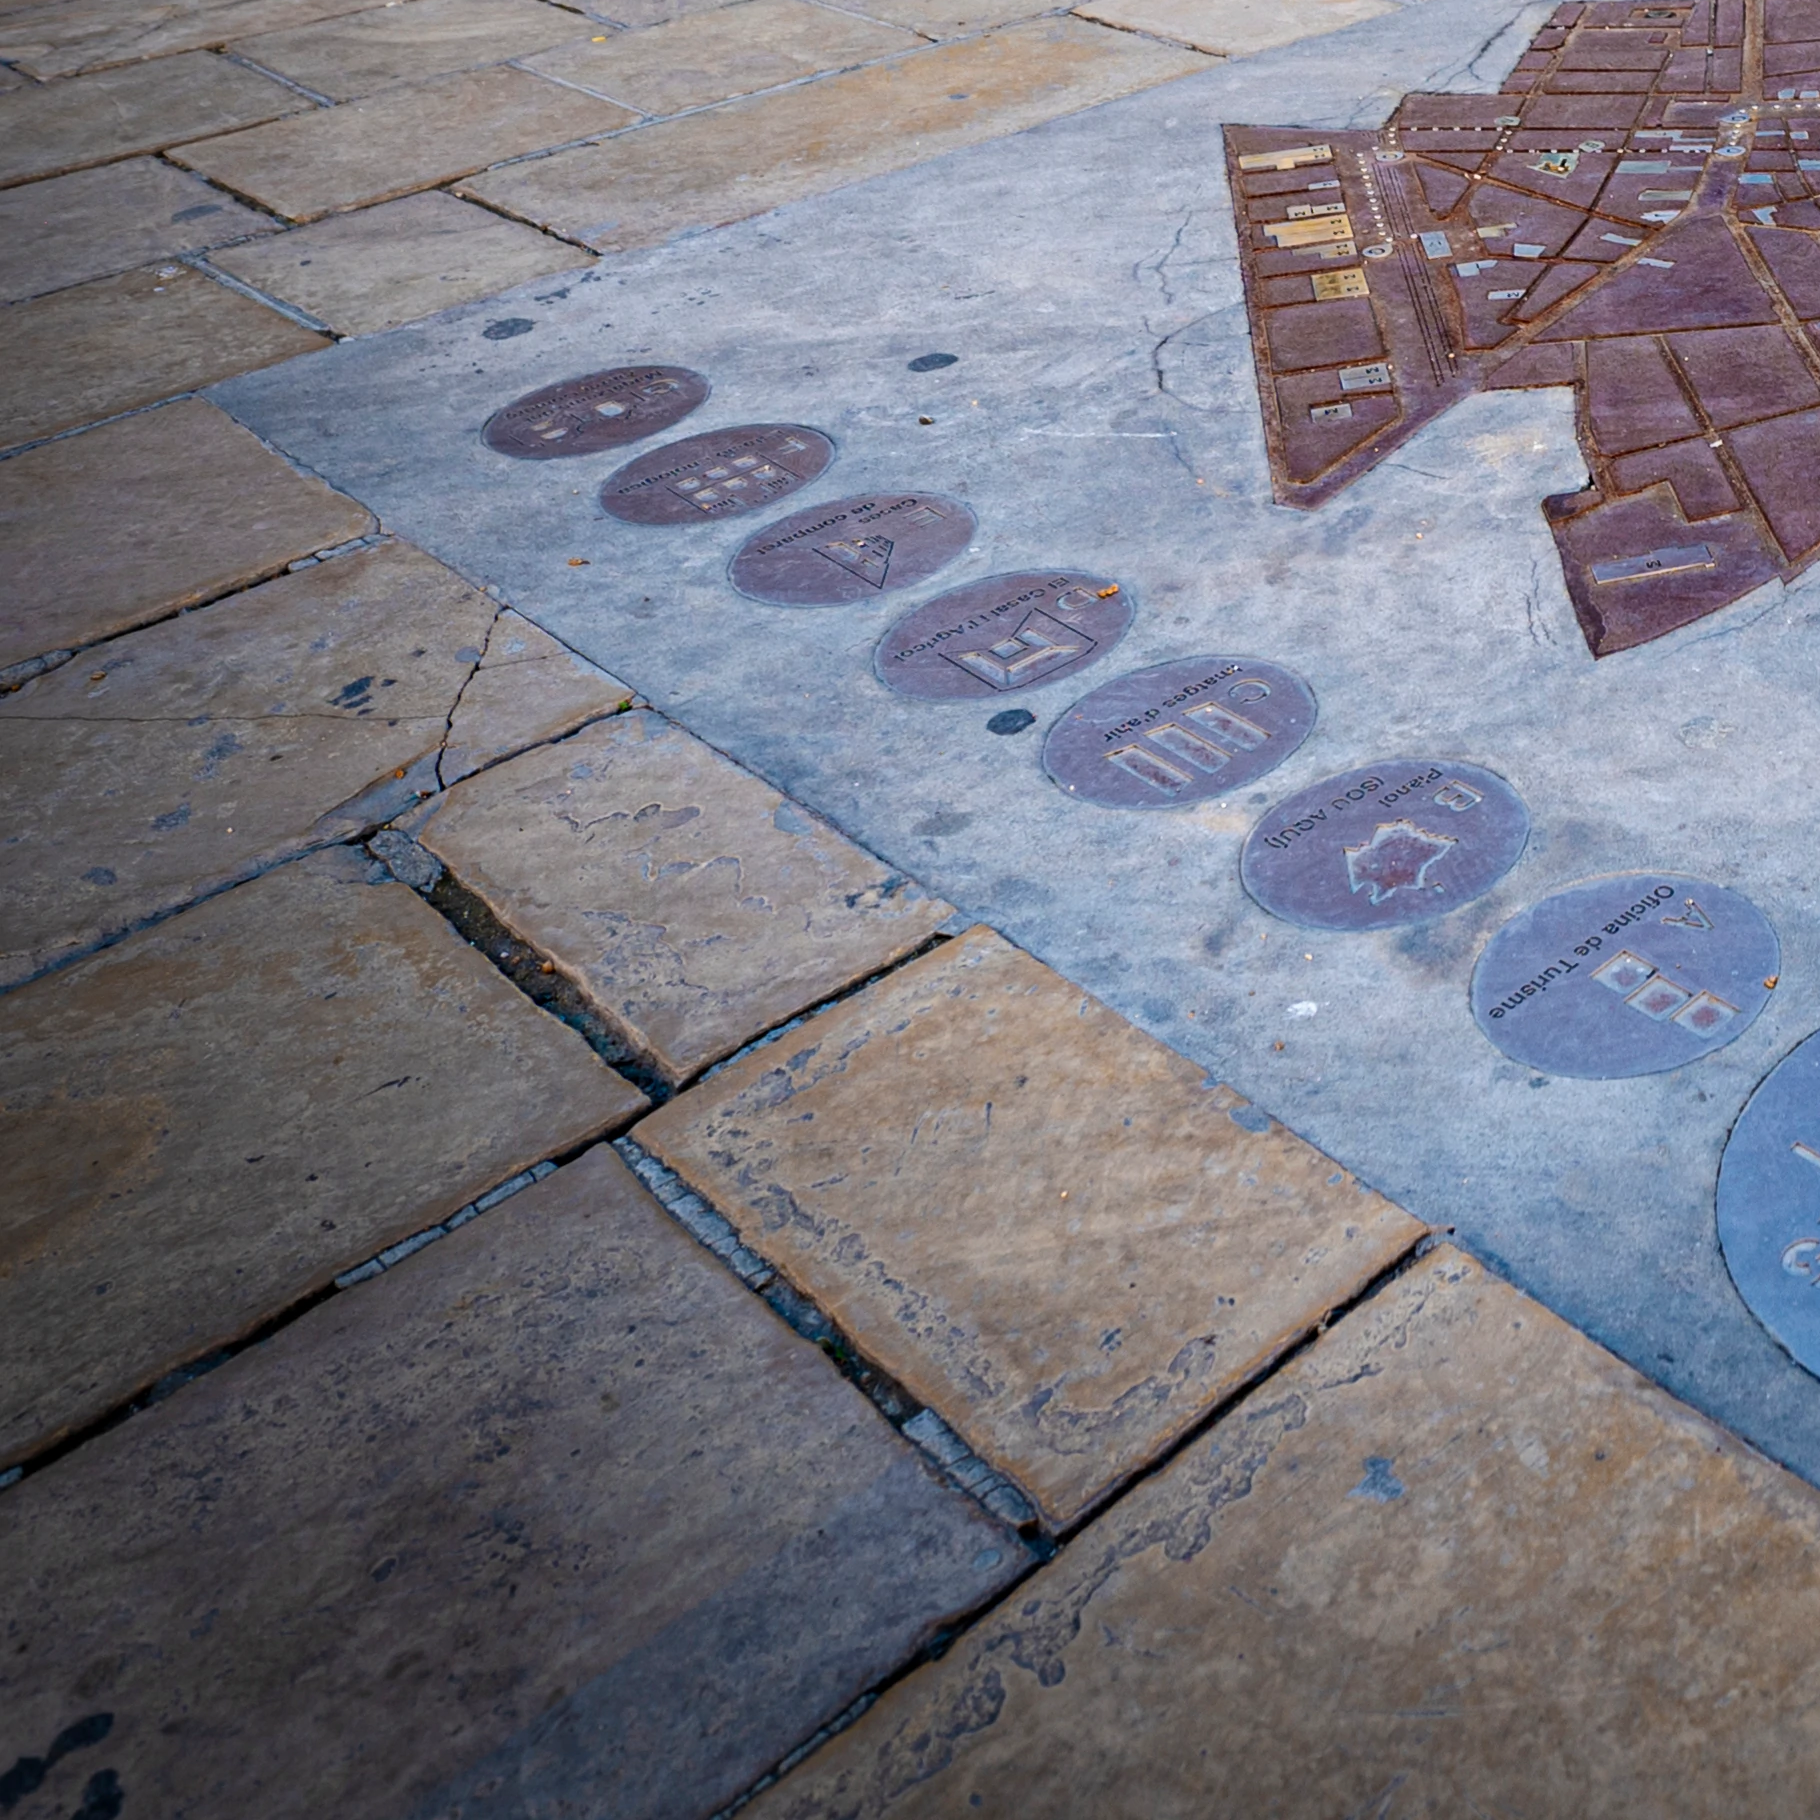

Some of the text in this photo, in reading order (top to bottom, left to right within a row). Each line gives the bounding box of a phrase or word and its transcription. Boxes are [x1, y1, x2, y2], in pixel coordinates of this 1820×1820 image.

[752, 501, 879, 555] de comparet
[856, 498, 920, 525] Cases
[1045, 576, 1071, 589] El
[988, 587, 1049, 616] Casal
[1056, 588, 1097, 612] D
[1097, 663, 1245, 743] Imatges d'ahir
[1226, 676, 1273, 705] C
[1376, 767, 1444, 808] Plànol
[1433, 778, 1485, 813] B
[1261, 775, 1387, 851] (SOU AQUÍ)
[1661, 898, 1715, 932] A
[1485, 883, 1678, 1023] Oficina de Turisme
